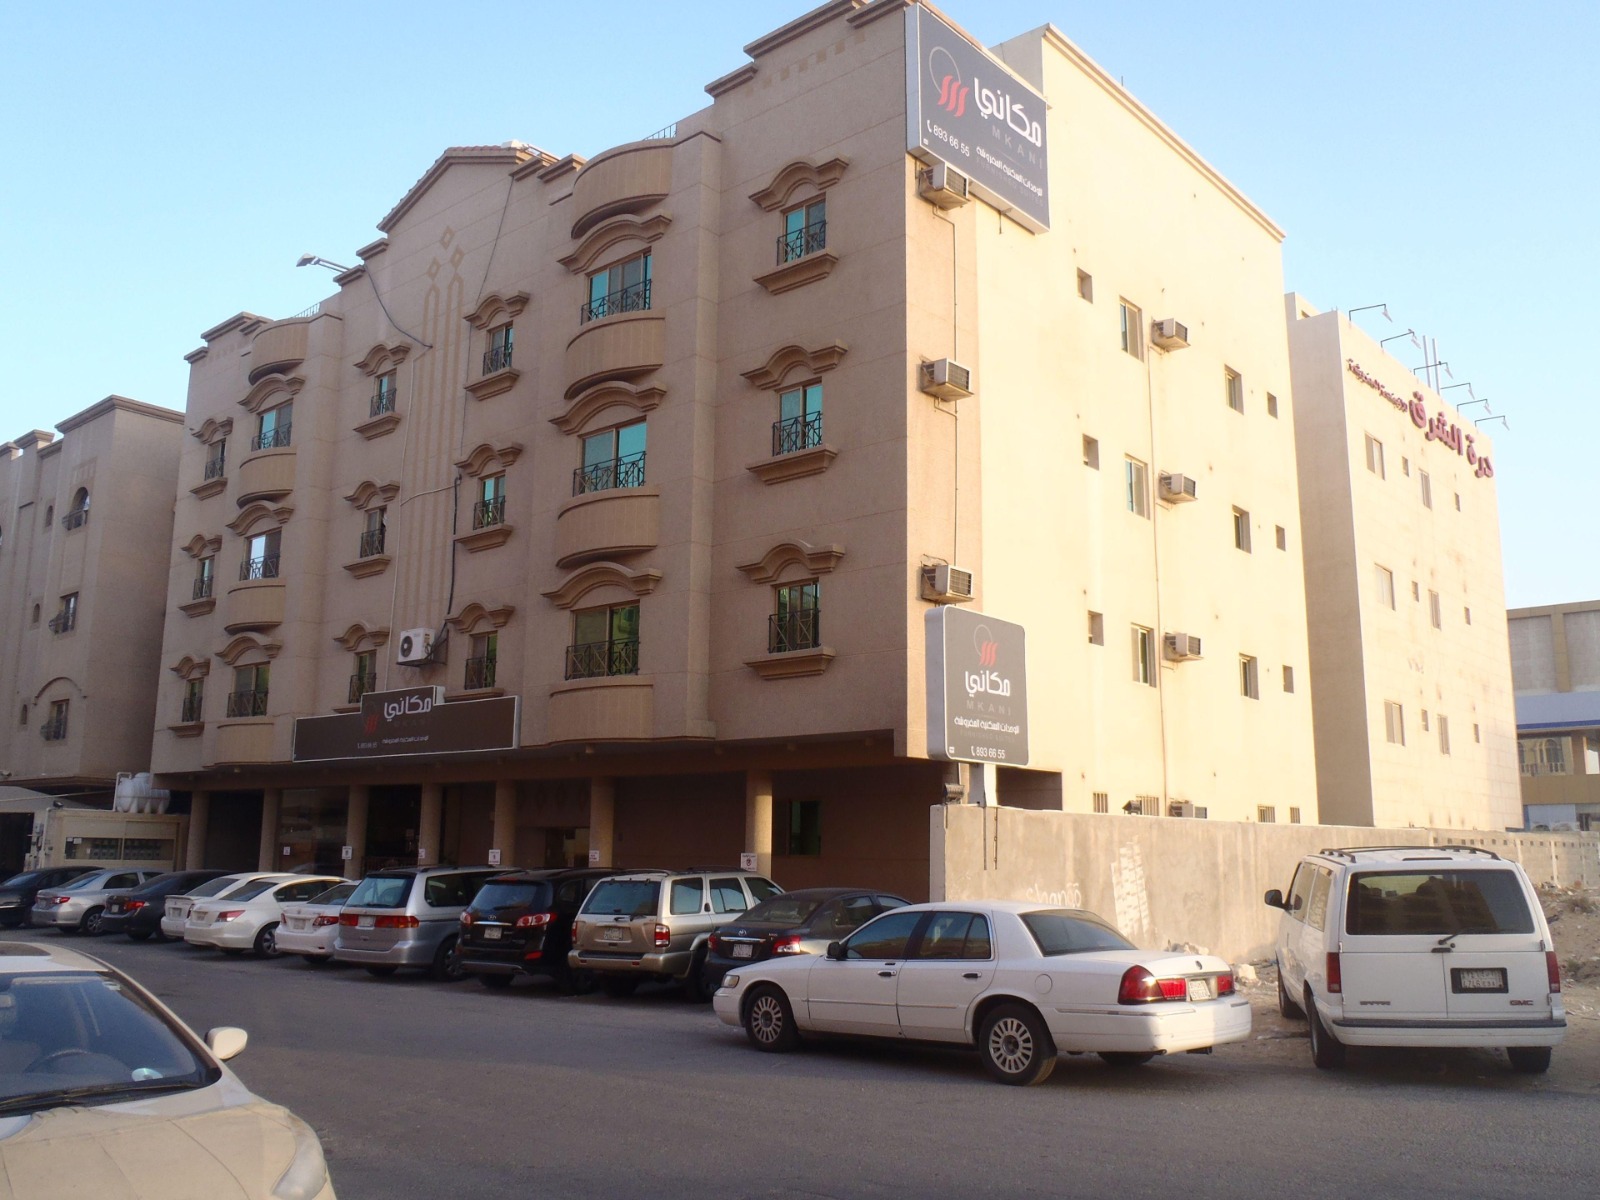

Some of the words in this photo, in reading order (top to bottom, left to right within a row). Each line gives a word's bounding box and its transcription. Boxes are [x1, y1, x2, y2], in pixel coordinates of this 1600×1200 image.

[974, 77, 1042, 147] مكاني
[933, 124, 948, 142] 893
[965, 670, 1011, 697] مكاني
[383, 695, 432, 722] مكاني
